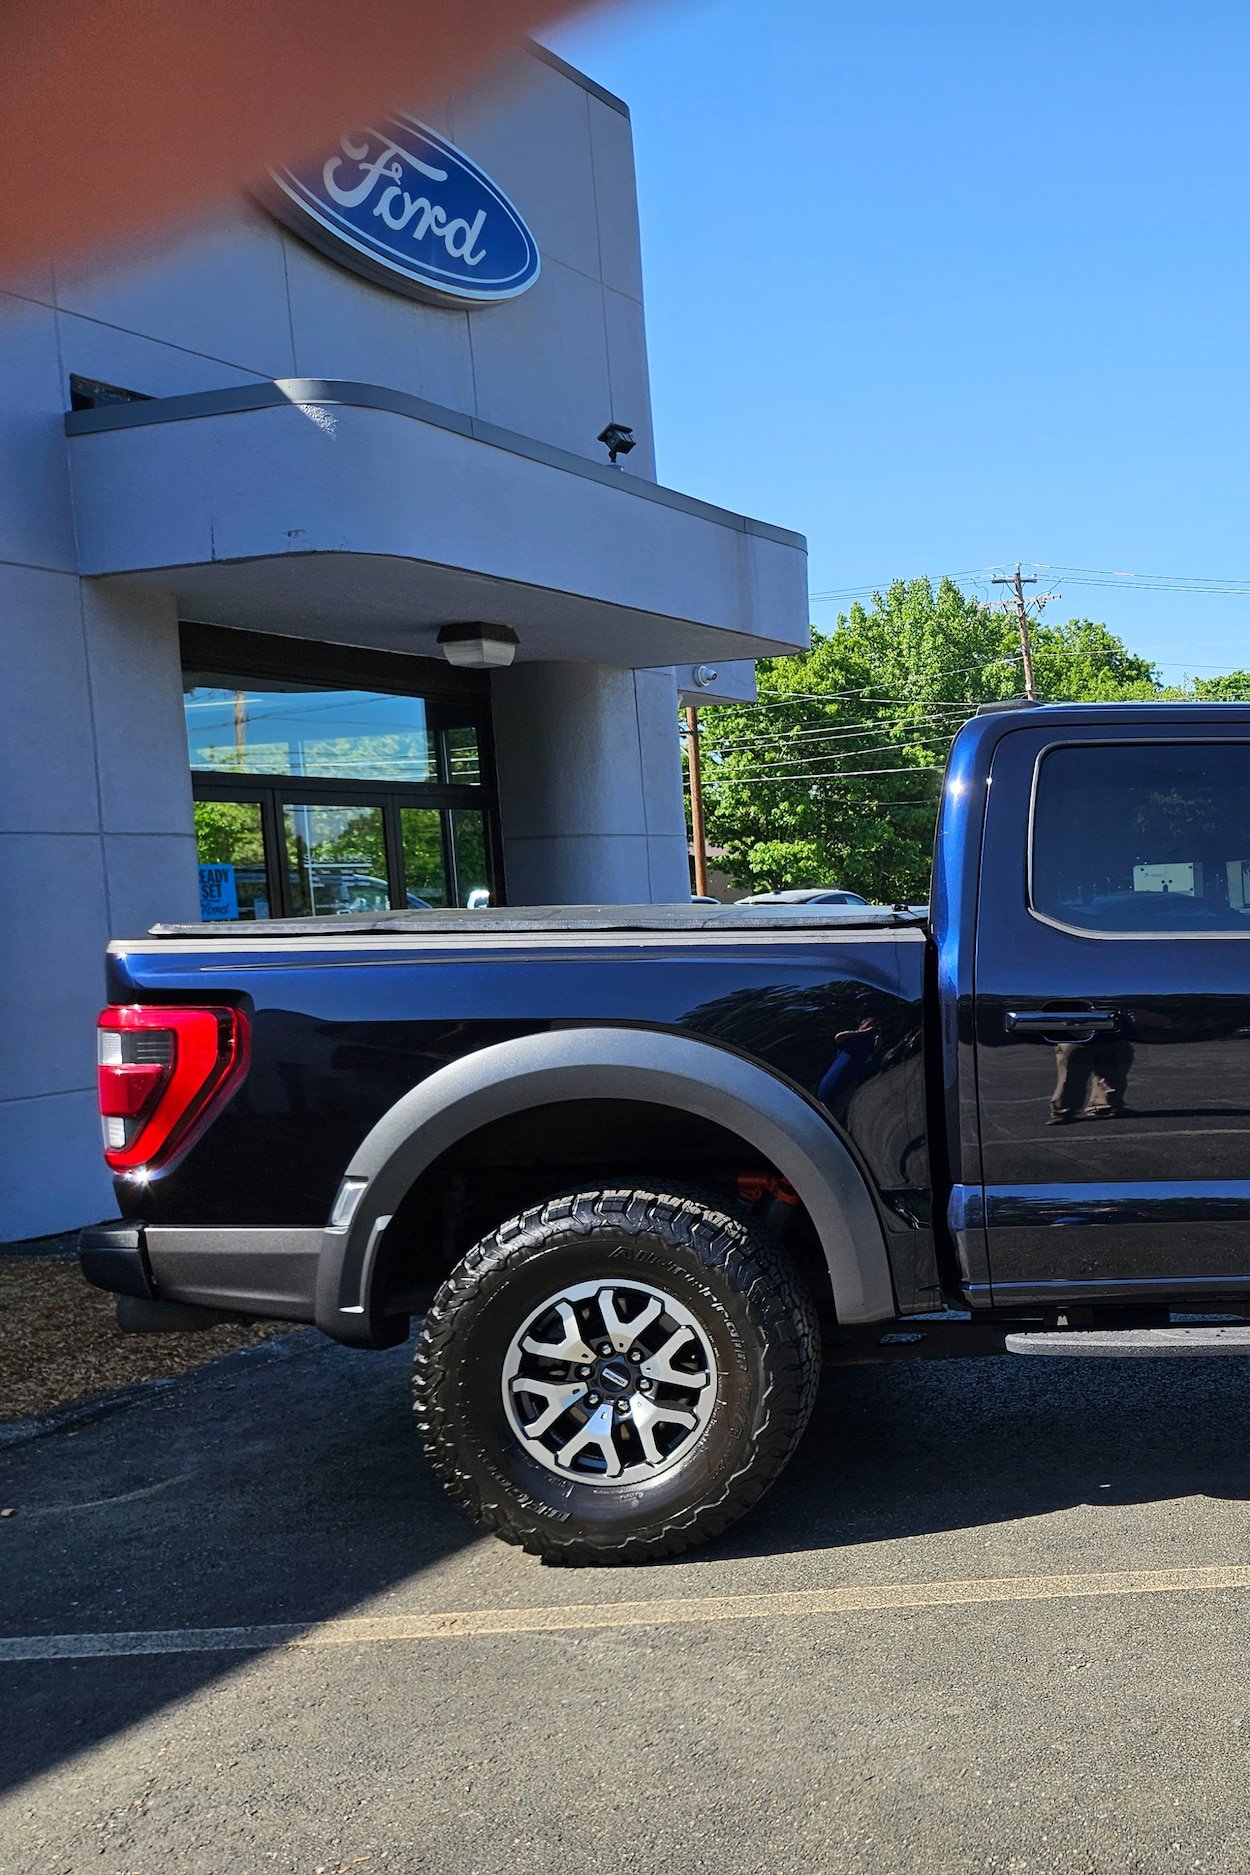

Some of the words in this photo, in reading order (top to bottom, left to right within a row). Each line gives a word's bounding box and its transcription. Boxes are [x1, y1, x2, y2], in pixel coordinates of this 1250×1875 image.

[322, 127, 487, 266] Ford
[198, 868, 229, 883] EADY
[202, 883, 222, 899] SET
